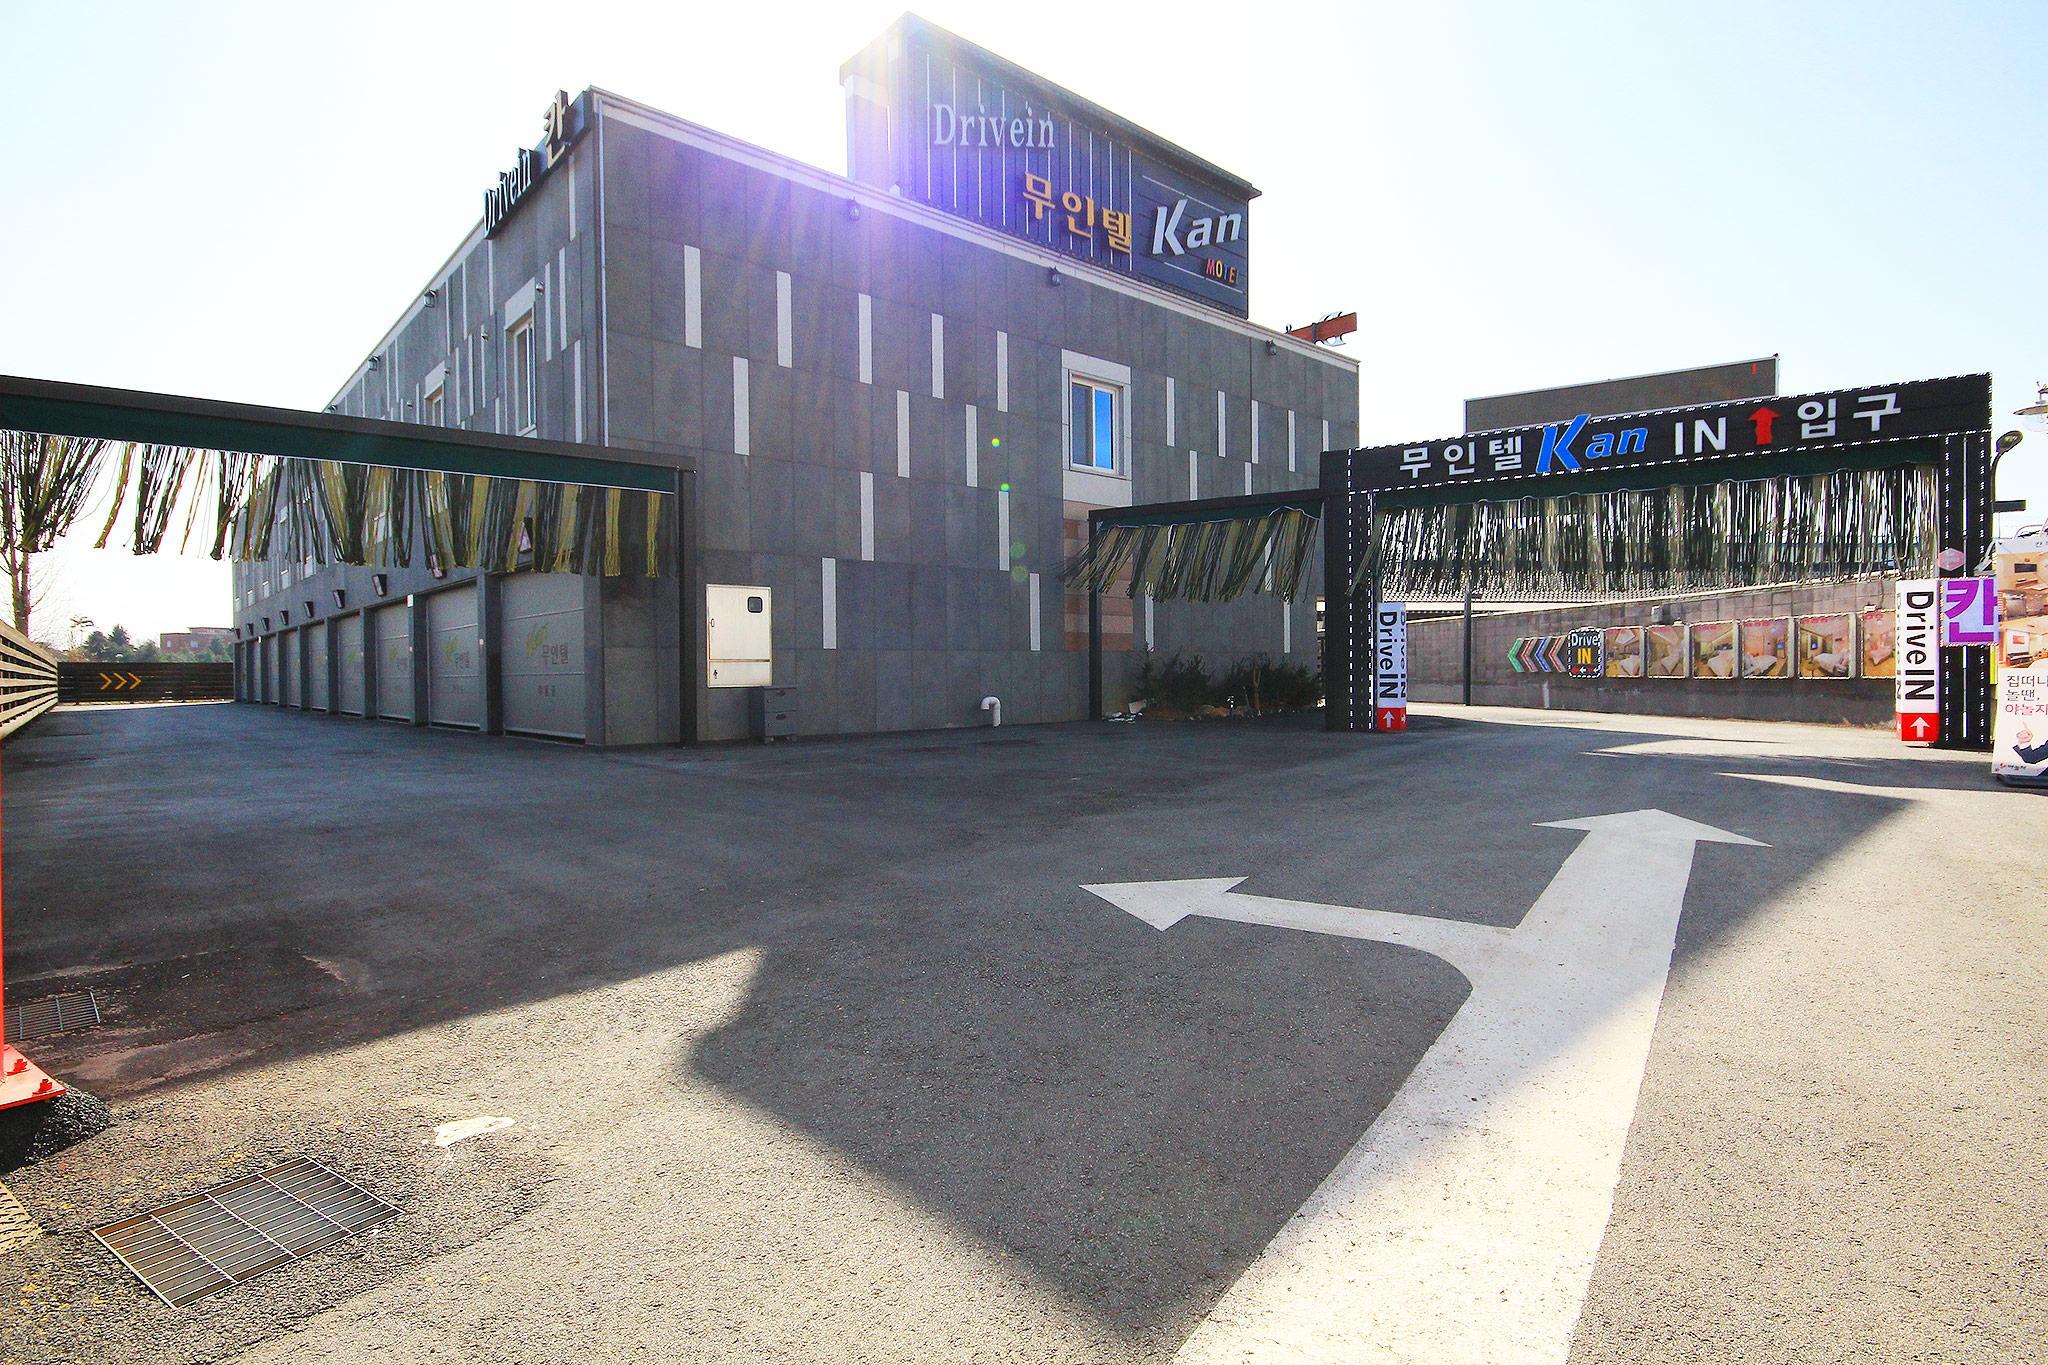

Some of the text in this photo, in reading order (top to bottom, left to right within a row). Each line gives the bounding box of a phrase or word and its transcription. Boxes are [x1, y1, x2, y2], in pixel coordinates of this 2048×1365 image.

[934, 101, 1055, 148] Drivein
[1023, 172, 1132, 254] 무인텔
[1152, 199, 1243, 256] Kan
[1399, 393, 1902, 478] 무인텔 Kan IN 입구
[1571, 633, 1599, 647] Drive
[1944, 579, 1998, 643] 칸
[1379, 611, 1398, 699] DriveIN
[1577, 648, 1592, 665] IN
[1905, 591, 1935, 700] DriveIN
